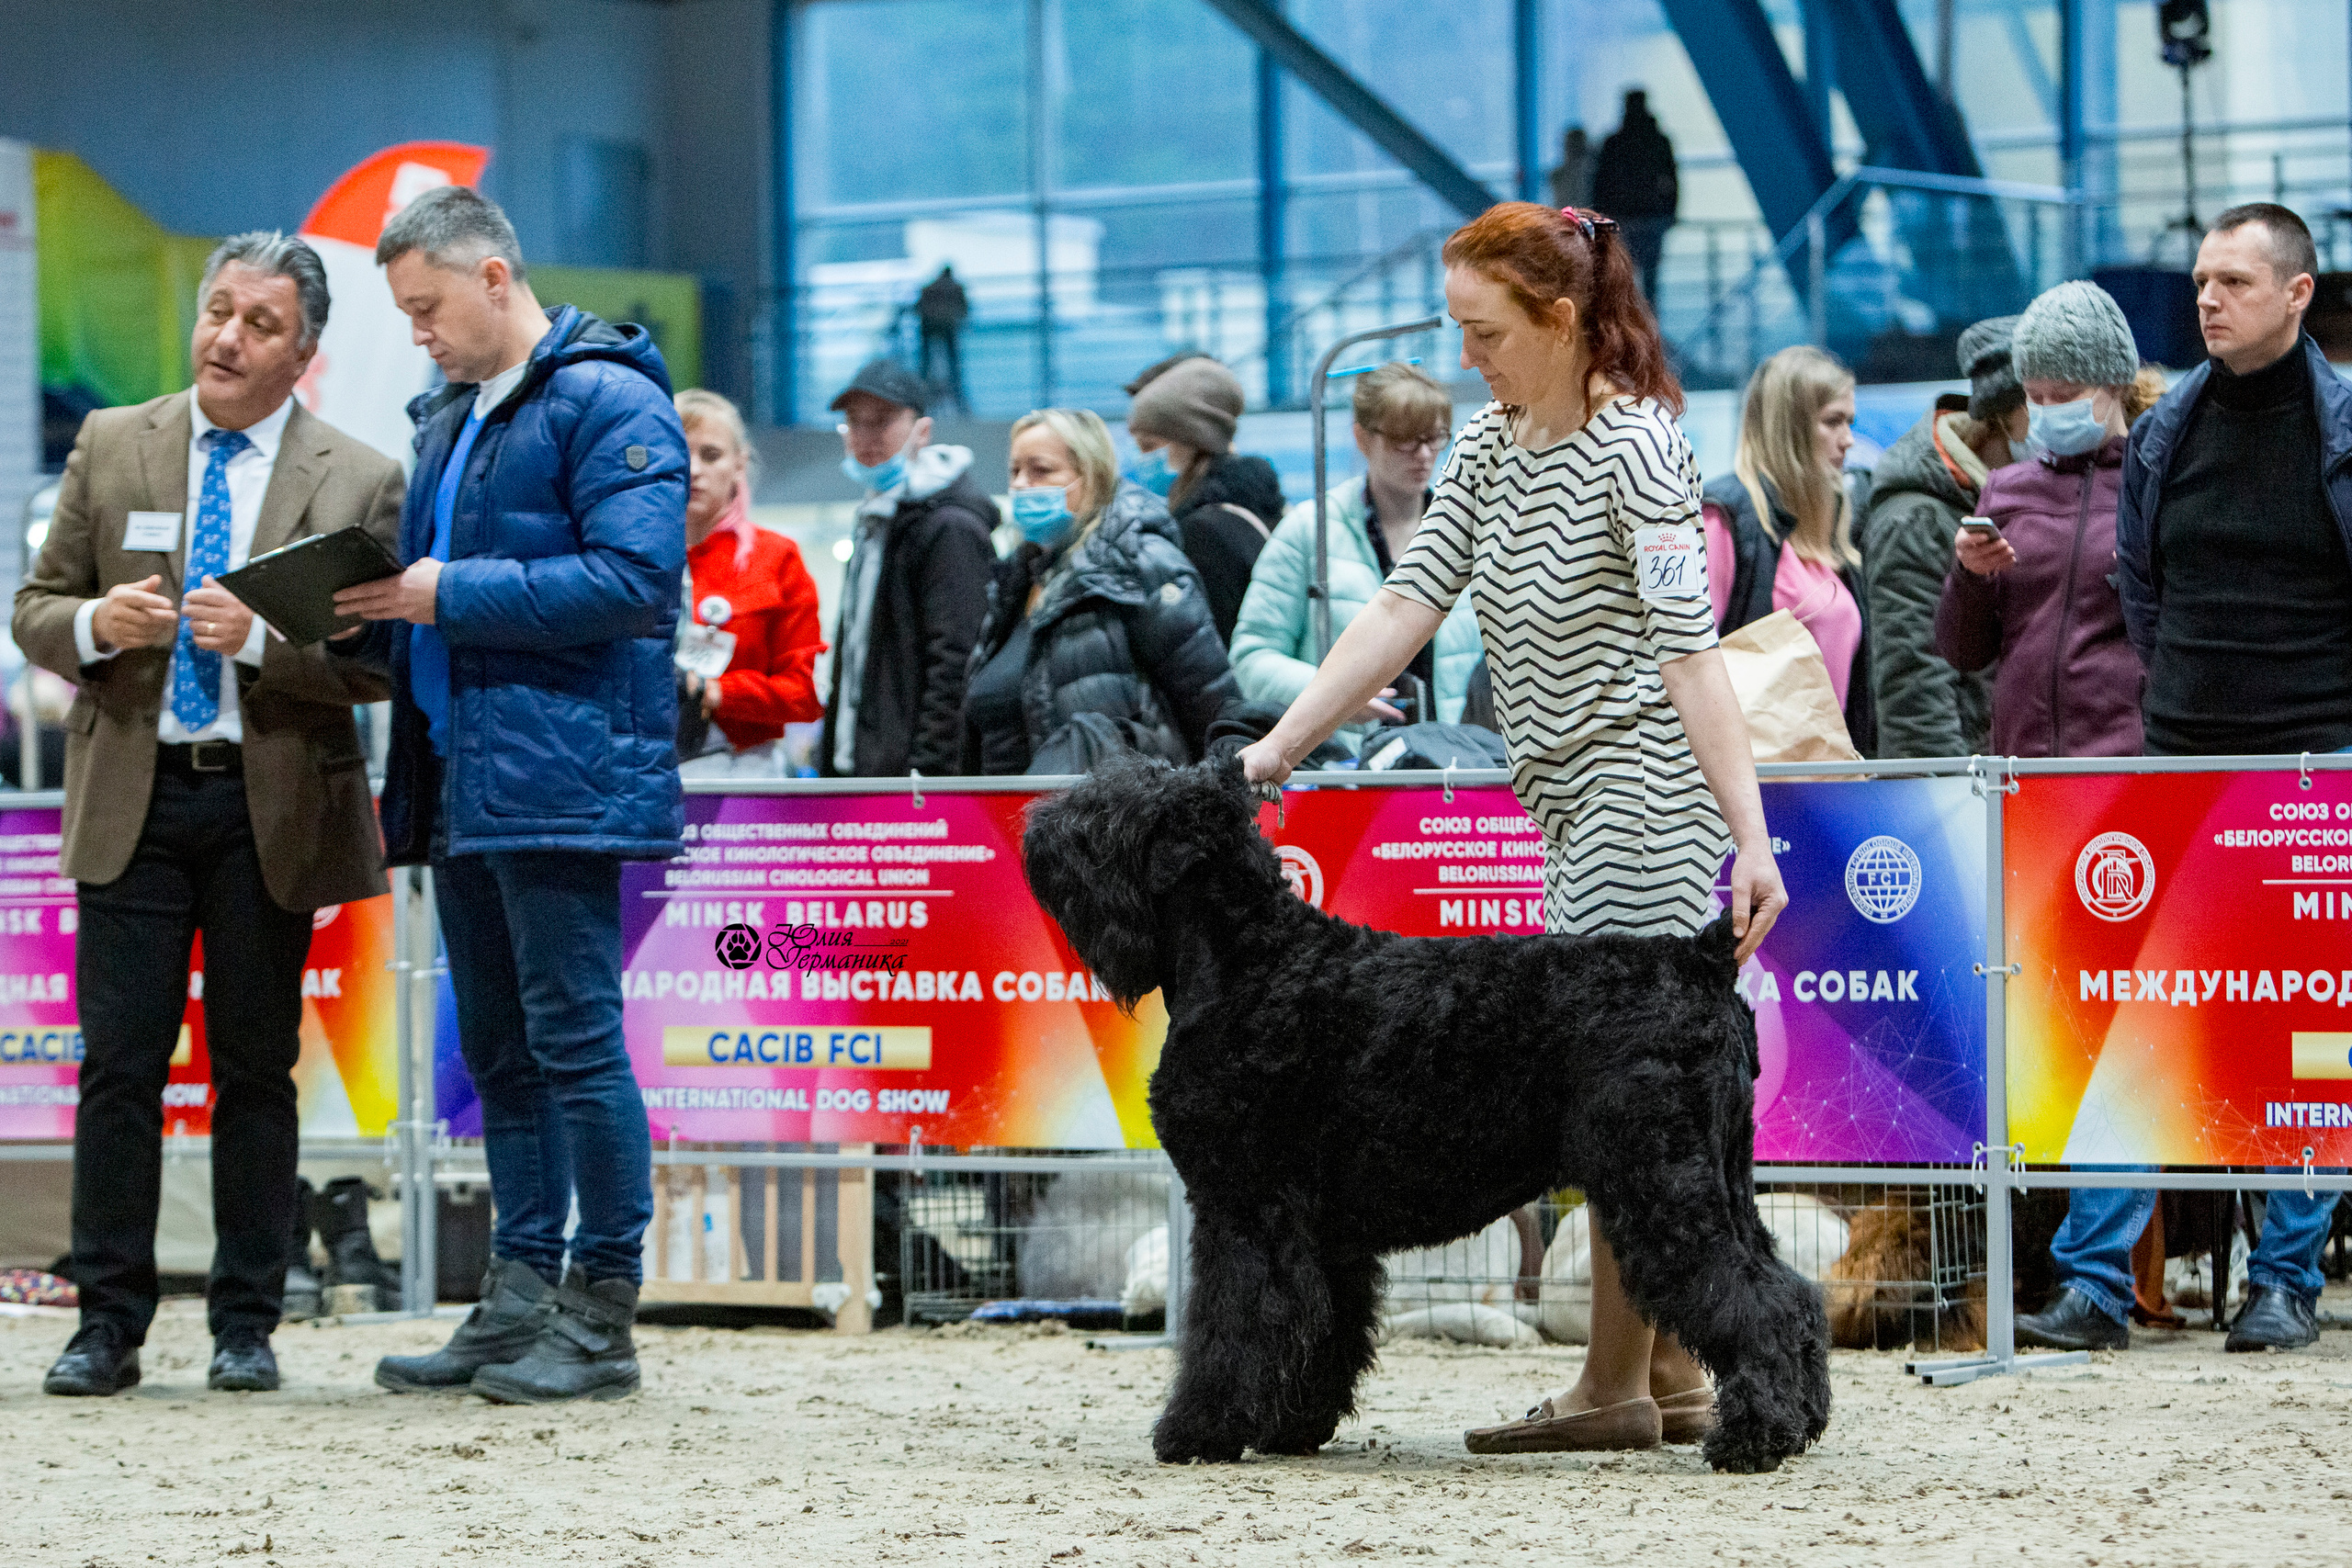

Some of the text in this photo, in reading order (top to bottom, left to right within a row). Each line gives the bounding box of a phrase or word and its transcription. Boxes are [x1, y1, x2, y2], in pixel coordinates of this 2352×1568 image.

[1644, 544, 1667, 552] ROYAL
[1648, 555, 1687, 590] 361
[2269, 802, 2352, 821] СОЮЗ О
[1419, 816, 1538, 836] СОЮЗ ОБЩЕС
[2213, 829, 2352, 848] «БЕЛОРУССКО
[1372, 840, 1547, 860] «БЕЛОРУССКОЕ КИНО
[1438, 865, 1544, 883] BELORUSSIAN
[2291, 855, 2352, 873] BELOR
[877, 868, 930, 886] UNION
[665, 900, 930, 929] MINSK BELARUS
[1440, 898, 1544, 927] MINSK
[801, 970, 984, 1002] ВЫСТАВКА
[1793, 970, 1919, 1002] СОБАК
[707, 1032, 881, 1065] CACIB FCI
[641, 1086, 950, 1113] INTERNATIONAL DOG SHOW
